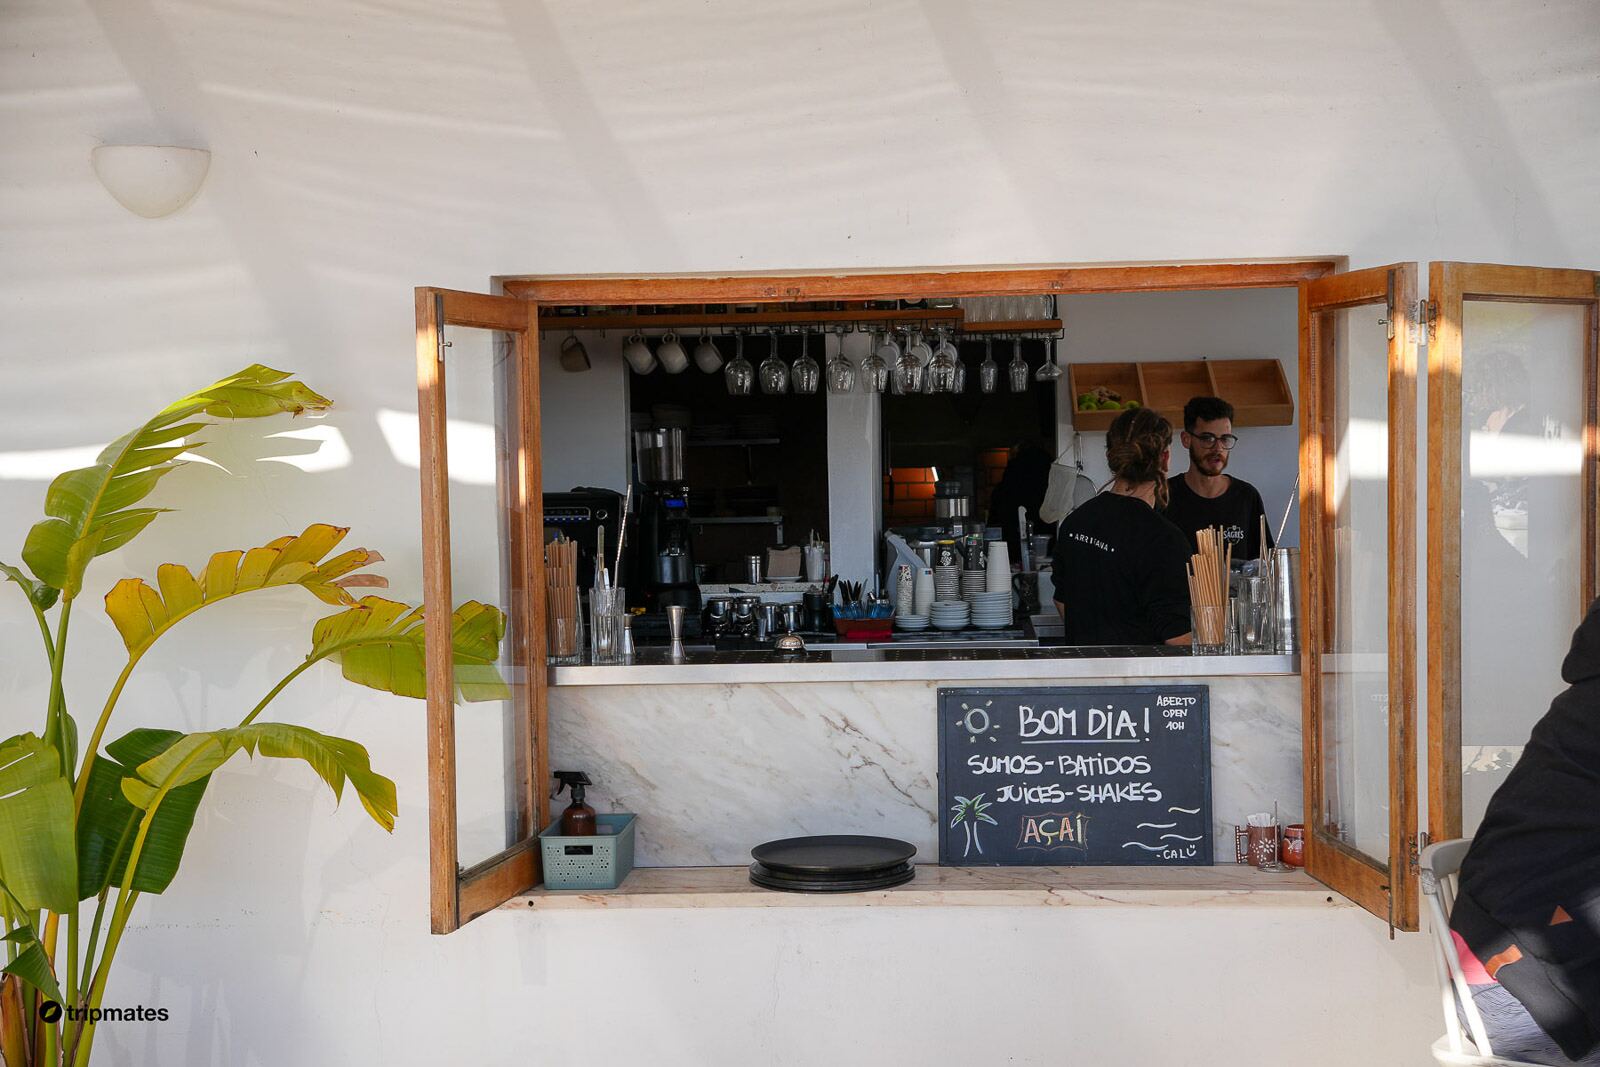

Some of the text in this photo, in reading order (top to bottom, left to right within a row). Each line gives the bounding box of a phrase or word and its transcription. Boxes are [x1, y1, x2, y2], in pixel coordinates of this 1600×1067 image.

[1156, 695, 1197, 707] ABERTO
[1162, 709, 1188, 718] OPEN
[1018, 705, 1077, 737] BOM
[1165, 721, 1185, 731] 10H
